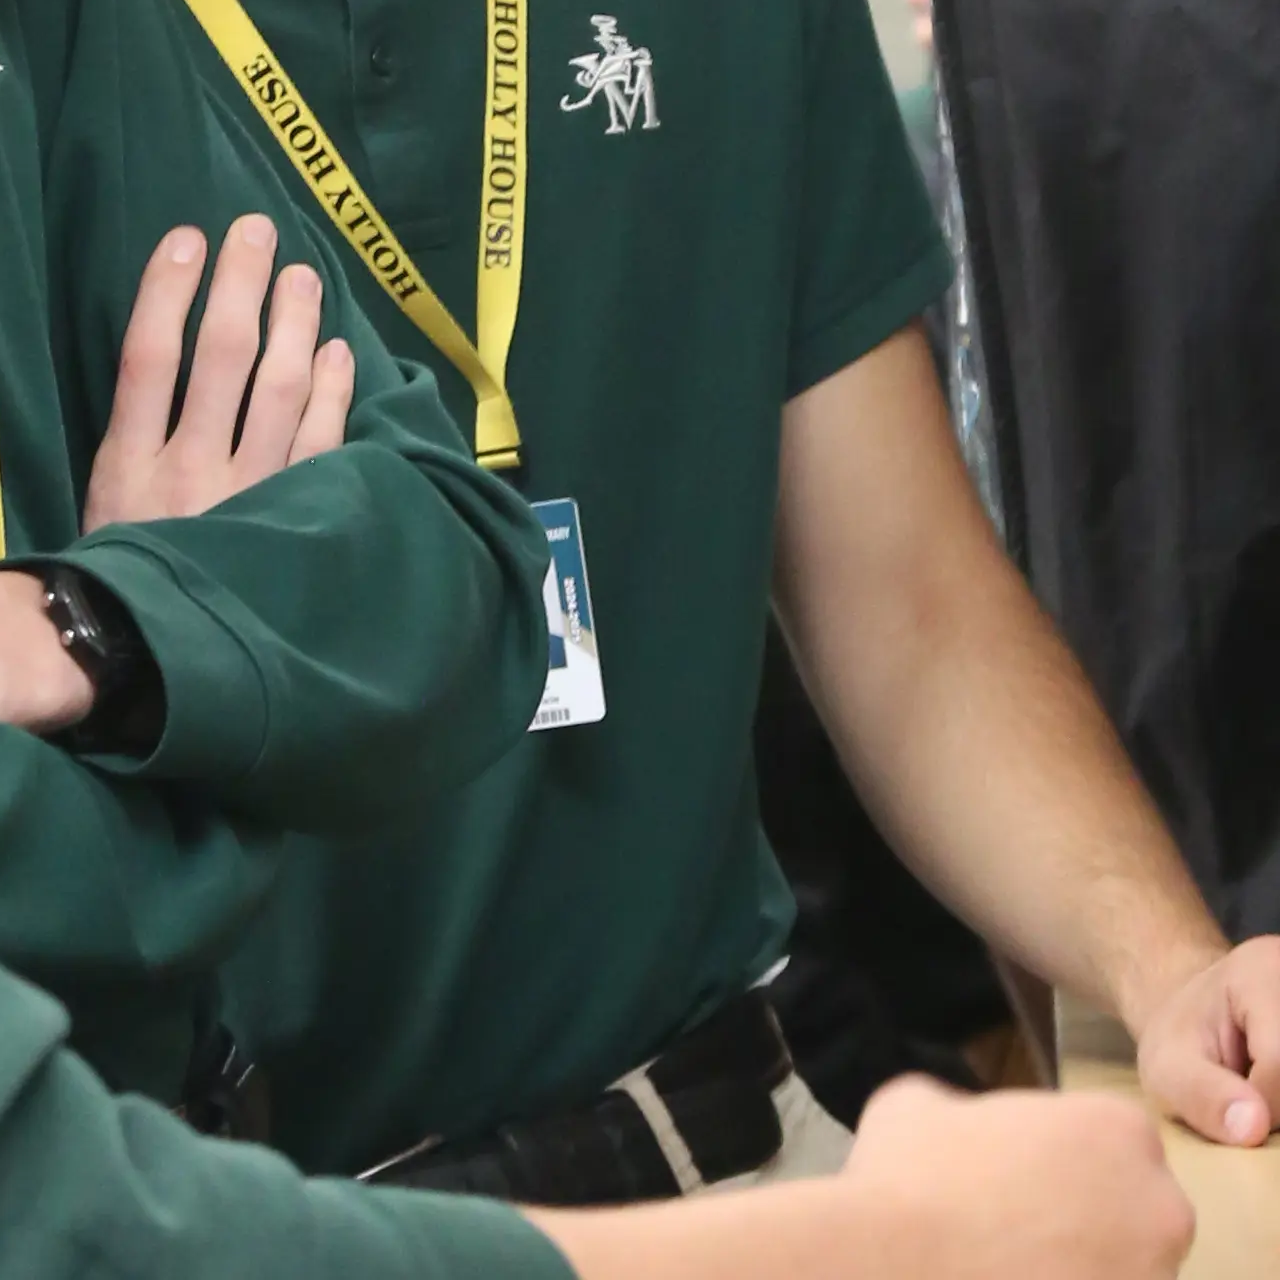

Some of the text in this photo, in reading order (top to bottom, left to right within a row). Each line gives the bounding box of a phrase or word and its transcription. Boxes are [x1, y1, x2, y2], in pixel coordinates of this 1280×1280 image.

[243, 54, 420, 303] HOLLY HOUSE
[484, 135, 517, 270] HOUSE
